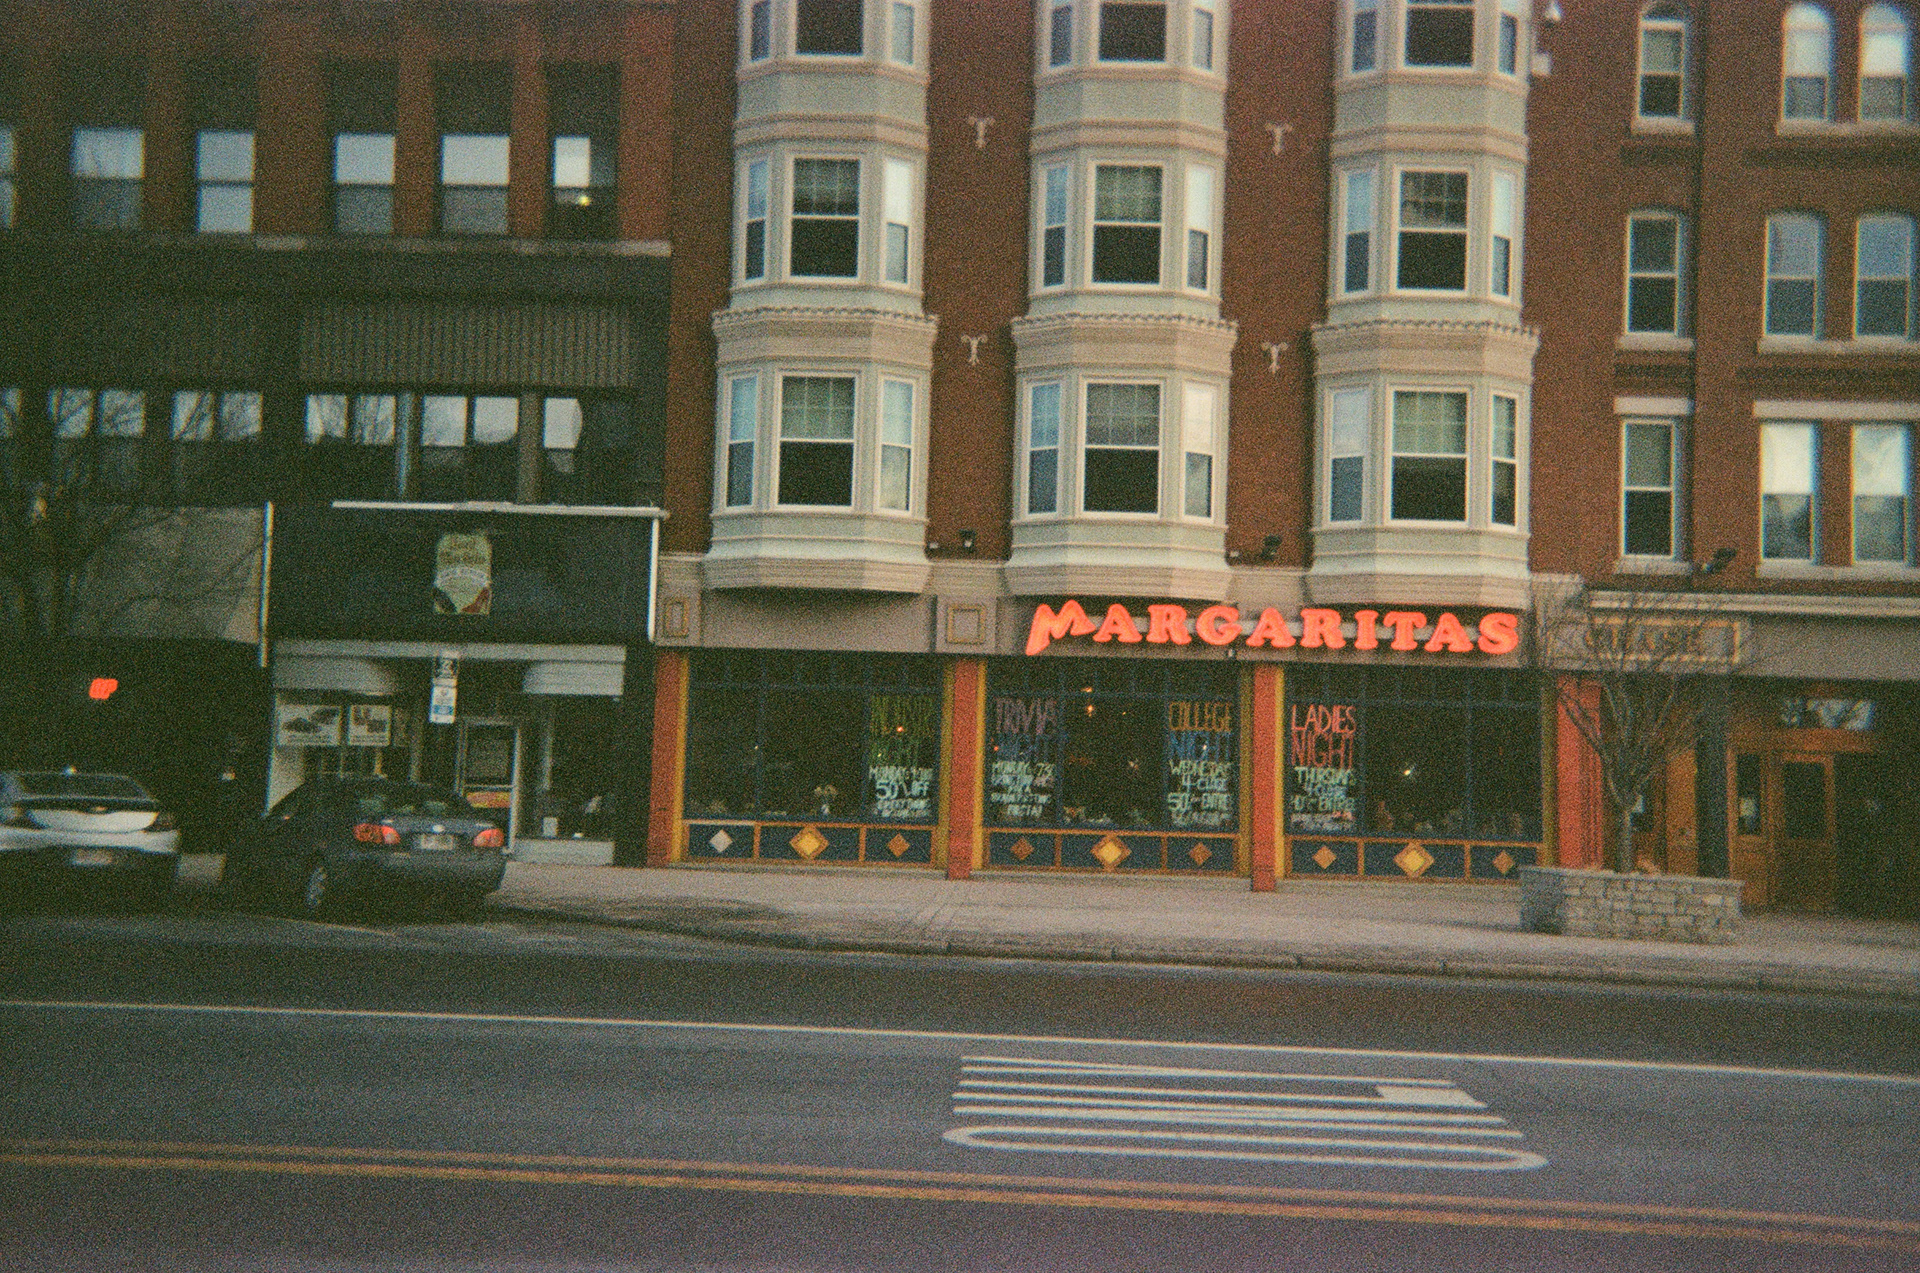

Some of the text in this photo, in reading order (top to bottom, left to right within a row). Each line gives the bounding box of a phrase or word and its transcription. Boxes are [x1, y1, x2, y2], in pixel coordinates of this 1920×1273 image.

[1025, 599, 1519, 655] MARGARITAS
[1169, 701, 1232, 732] COLLEGE
[1291, 704, 1356, 734] LADIES
[1170, 731, 1232, 762] NIGHT
[1291, 731, 1354, 768] NIGHT
